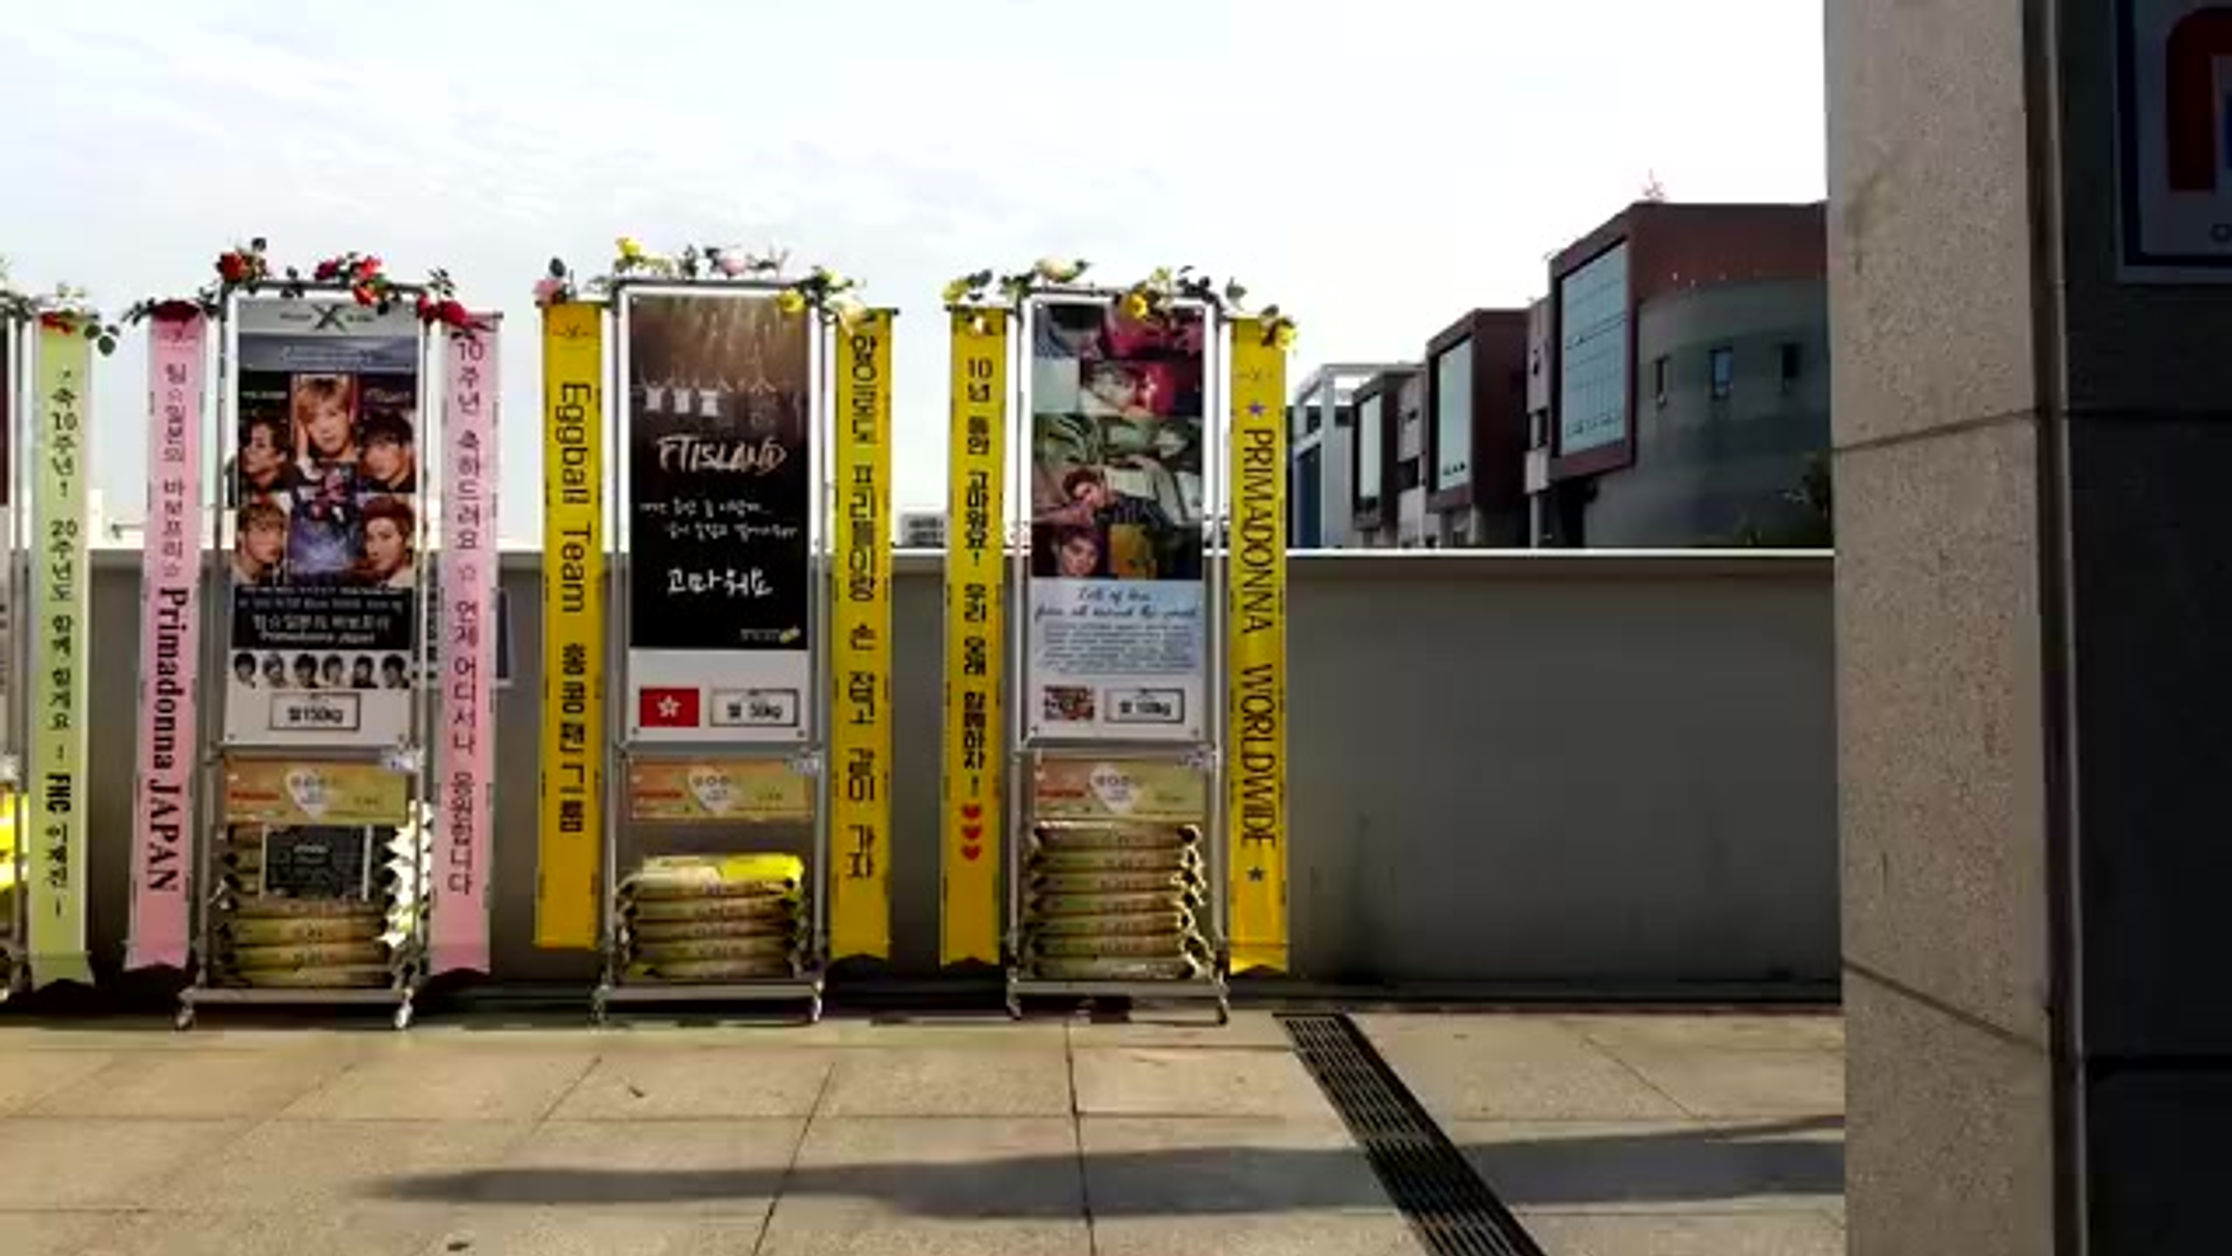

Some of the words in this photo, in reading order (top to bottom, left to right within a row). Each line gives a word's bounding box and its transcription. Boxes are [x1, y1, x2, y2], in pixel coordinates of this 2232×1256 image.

[457, 342, 485, 417] 10주년
[555, 382, 592, 505] Eggball
[561, 521, 592, 613] Team
[1239, 428, 1276, 634] PRIMADONNA
[453, 601, 478, 648] 언제
[851, 622, 877, 651] 손
[963, 583, 987, 623] 우리
[151, 587, 189, 772] Primadonna
[453, 656, 477, 755] 어디서나
[848, 671, 877, 725] 잡고
[1238, 663, 1277, 849] WORLDWIDE
[146, 780, 182, 893] JAPAN
[447, 771, 475, 897] 응원합니다
[846, 823, 875, 880] 가자
